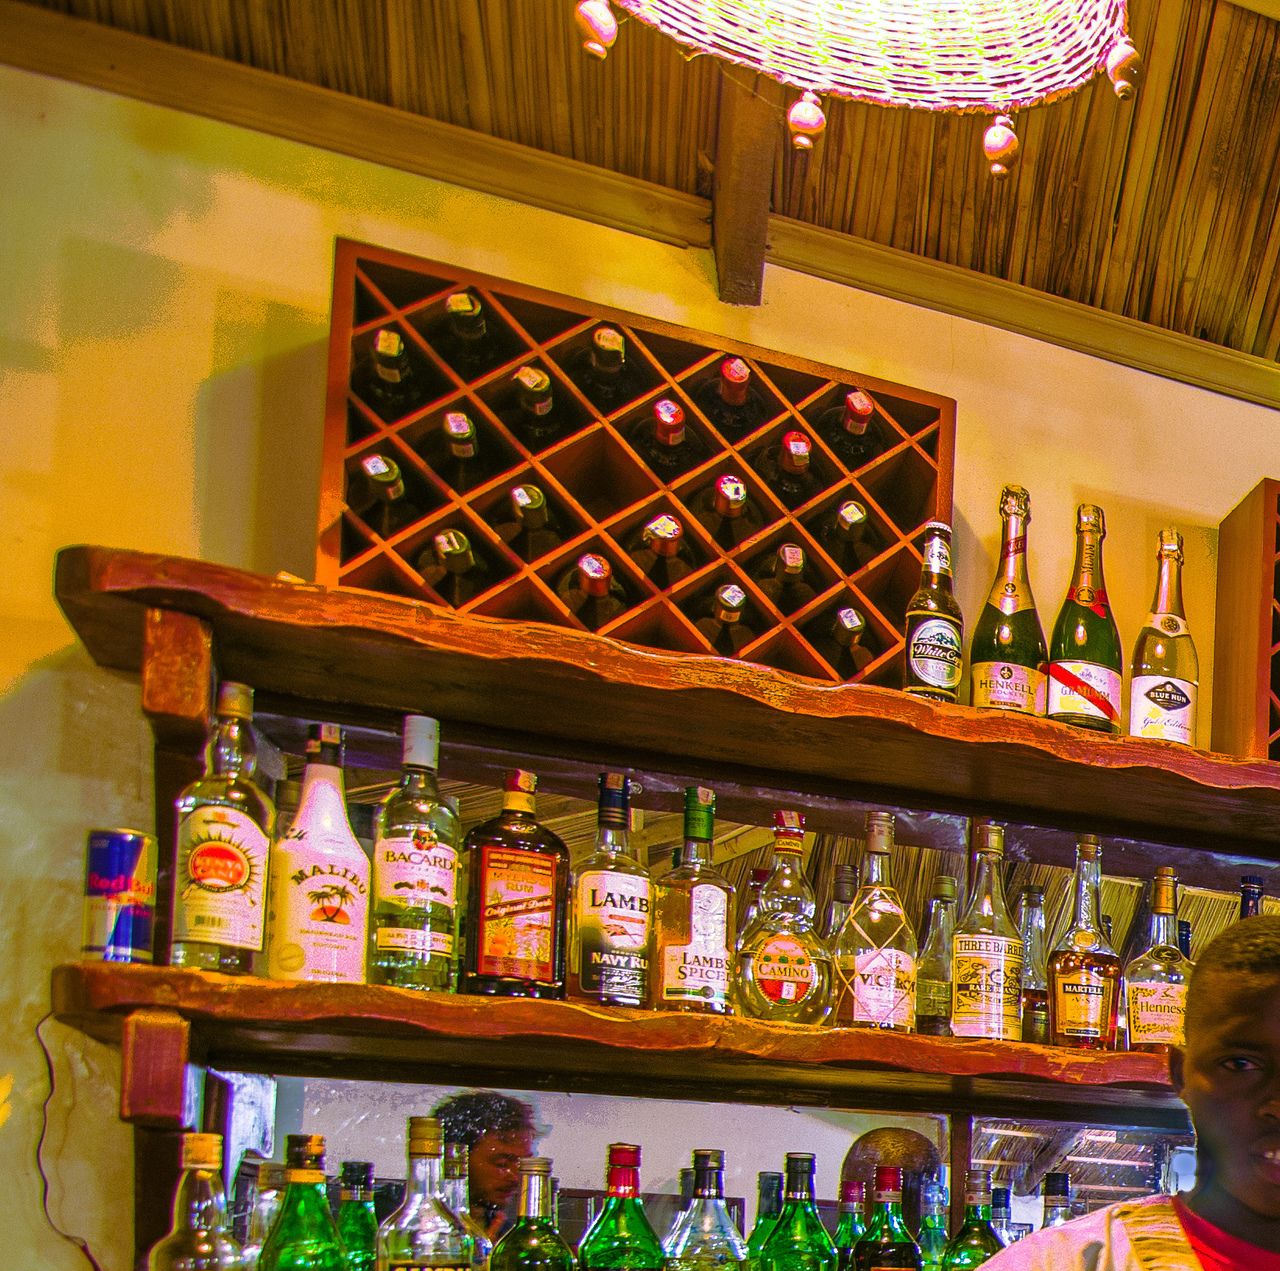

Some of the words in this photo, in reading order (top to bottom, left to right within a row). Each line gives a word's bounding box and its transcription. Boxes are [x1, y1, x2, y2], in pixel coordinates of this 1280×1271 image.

[979, 679, 1034, 696] HENKELL
[1150, 691, 1170, 699] BLUE
[1170, 694, 1187, 703] NUN
[291, 864, 368, 895] MALIBU
[959, 940, 991, 951] THREE
[592, 952, 628, 968] NAVY
[758, 962, 810, 980] CAMINO
[1064, 984, 1103, 995] MARTELL
